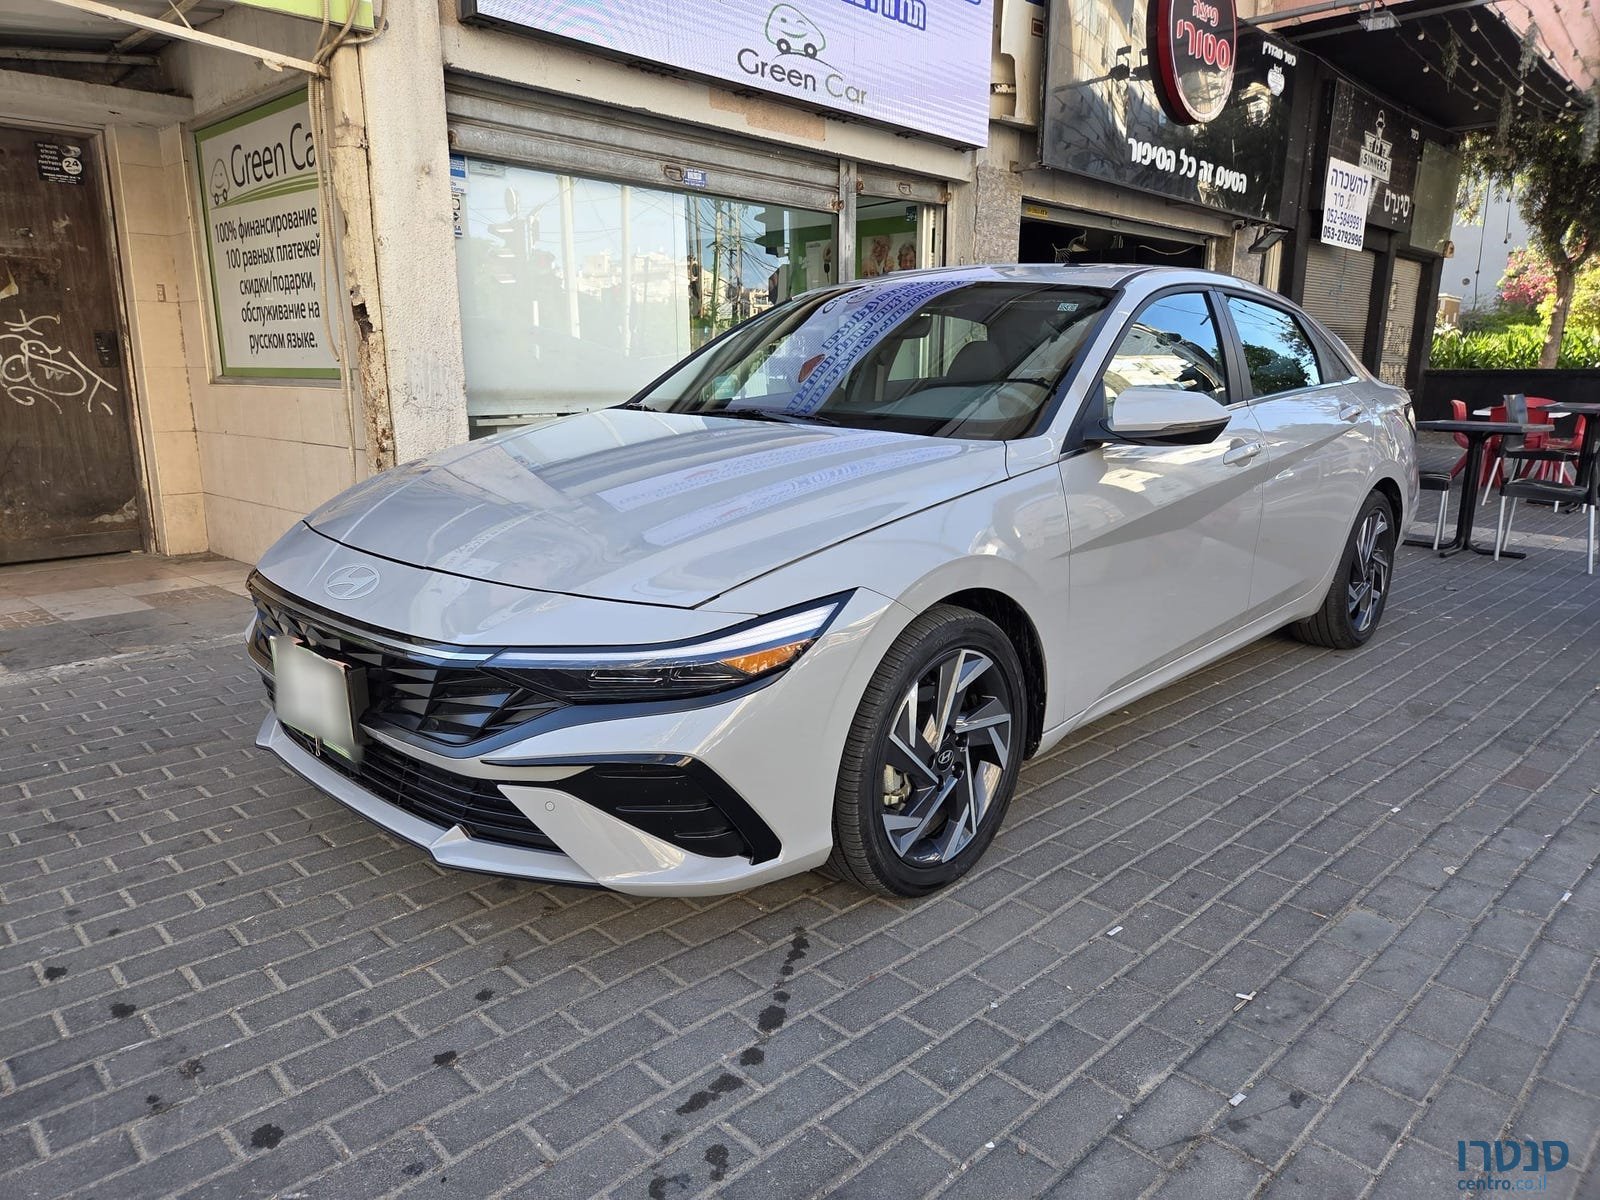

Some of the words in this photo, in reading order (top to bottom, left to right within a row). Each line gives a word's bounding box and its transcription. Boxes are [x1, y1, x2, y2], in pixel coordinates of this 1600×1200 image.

[1176, 19, 1231, 71] סטורי
[737, 48, 816, 92] Green
[825, 74, 867, 105] Car
[64, 160, 79, 168] 24
[231, 142, 287, 187] Green
[290, 122, 320, 171] Ca
[1128, 138, 1176, 173] הסיפור
[1179, 148, 1197, 178] כל
[1198, 160, 1214, 183] זה
[1215, 165, 1247, 194] הטעם
[1331, 168, 1368, 197] להשכרה
[215, 220, 237, 243] 100%
[238, 207, 318, 244] финансирование
[1323, 225, 1362, 247] 053-2792996
[226, 247, 241, 270] 100
[242, 245, 276, 273] равных
[277, 232, 320, 262] платежей
[240, 270, 316, 298] скидки/подарки,
[241, 301, 306, 327] обслуживание
[308, 301, 320, 319] на
[249, 332, 286, 354] русском
[287, 331, 318, 349] языке.
